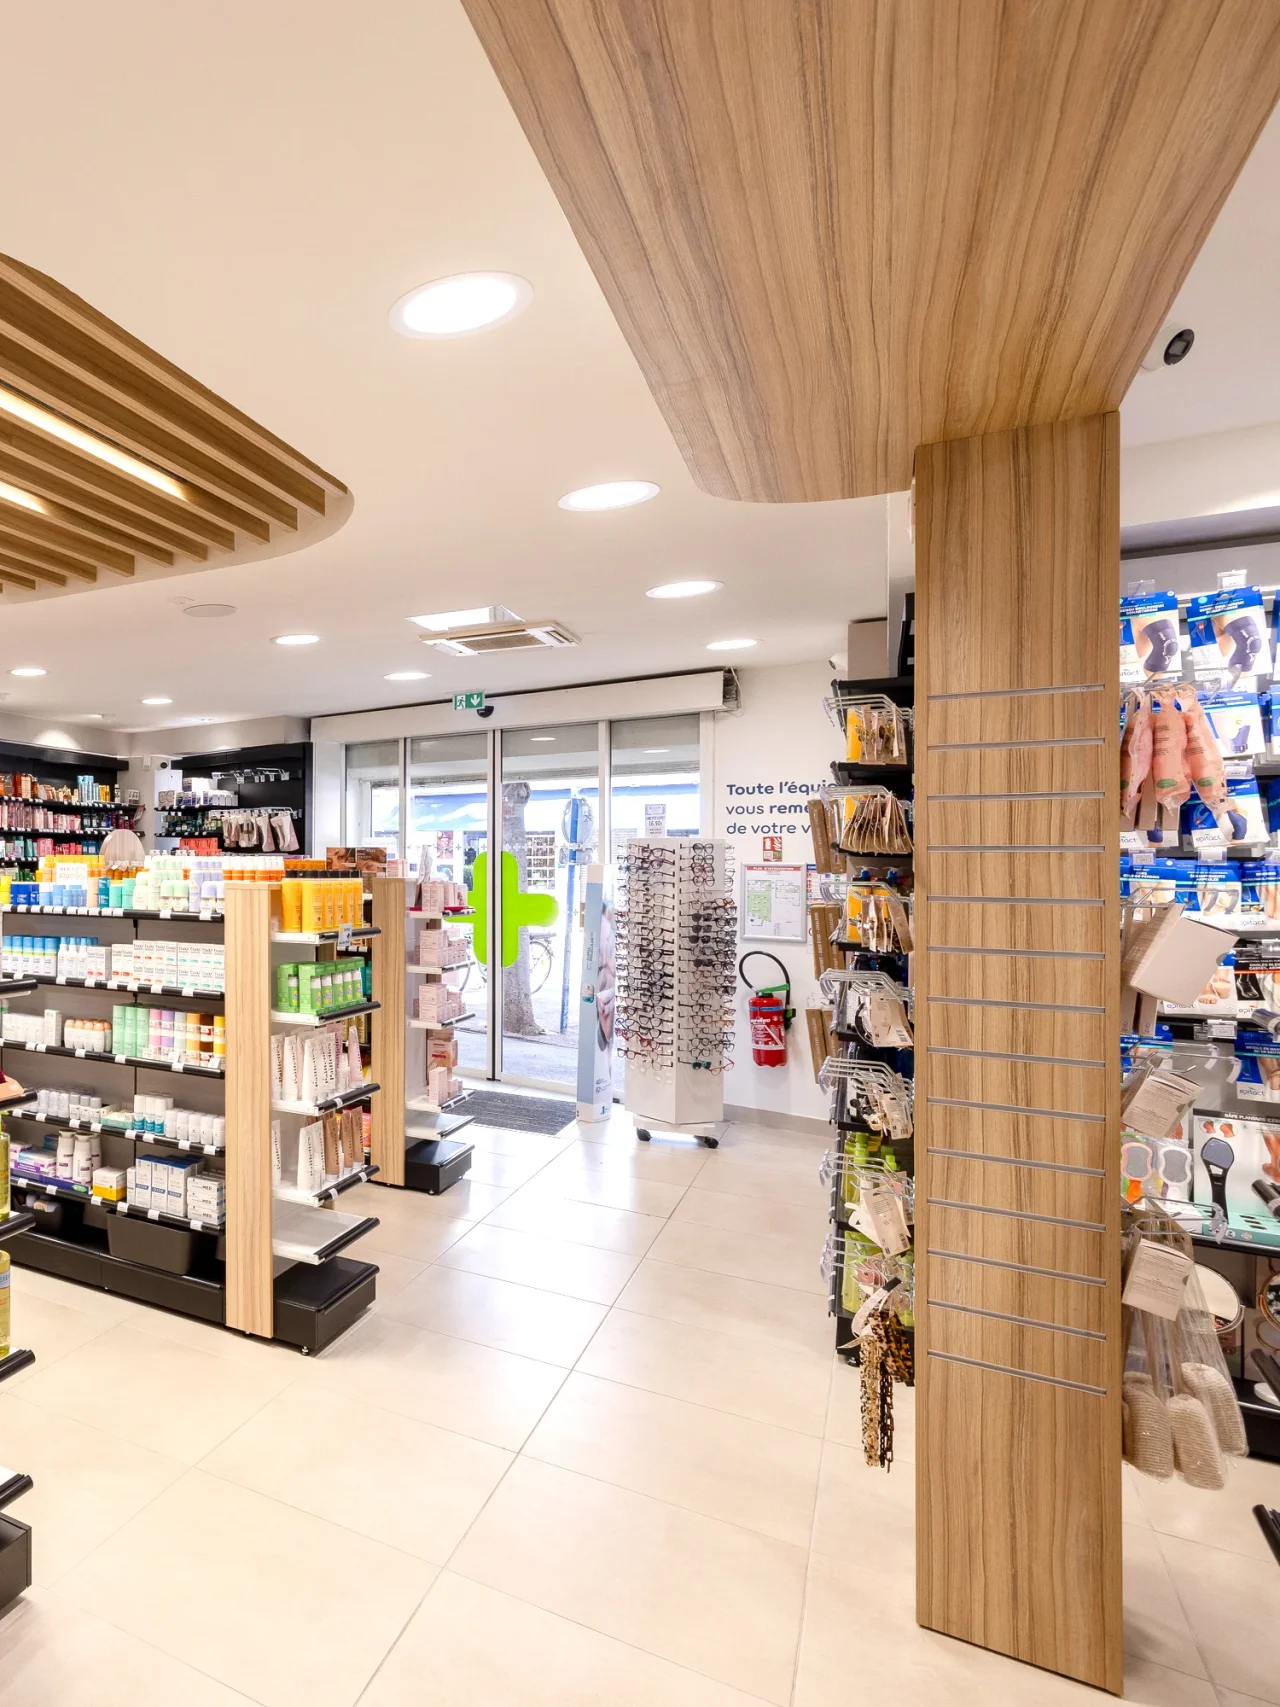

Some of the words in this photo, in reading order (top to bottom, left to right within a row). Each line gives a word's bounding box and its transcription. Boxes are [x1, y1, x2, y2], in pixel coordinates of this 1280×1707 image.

[726, 783, 774, 796] Toute
[779, 780, 840, 796] l’équi
[726, 805, 764, 815] vous
[726, 822, 747, 834] de
[751, 822, 796, 834] votre
[1196, 834, 1221, 842] epitact
[1239, 1089, 1265, 1097] epitact
